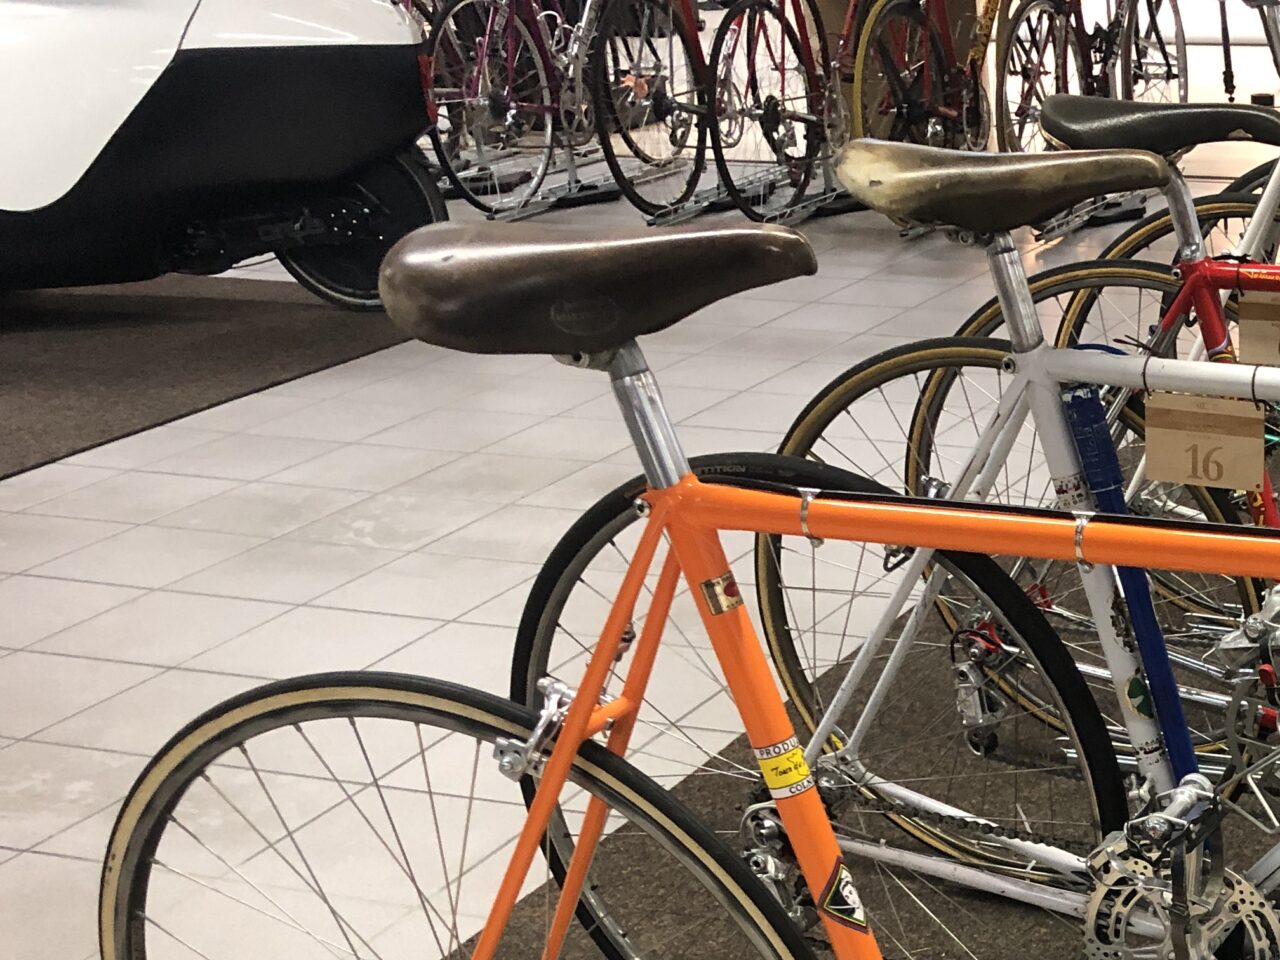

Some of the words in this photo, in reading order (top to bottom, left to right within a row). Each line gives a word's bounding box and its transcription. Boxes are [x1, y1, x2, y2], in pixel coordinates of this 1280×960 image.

[703, 465, 746, 474] TITION
[1185, 443, 1224, 481] 16
[789, 779, 812, 794] COLN
